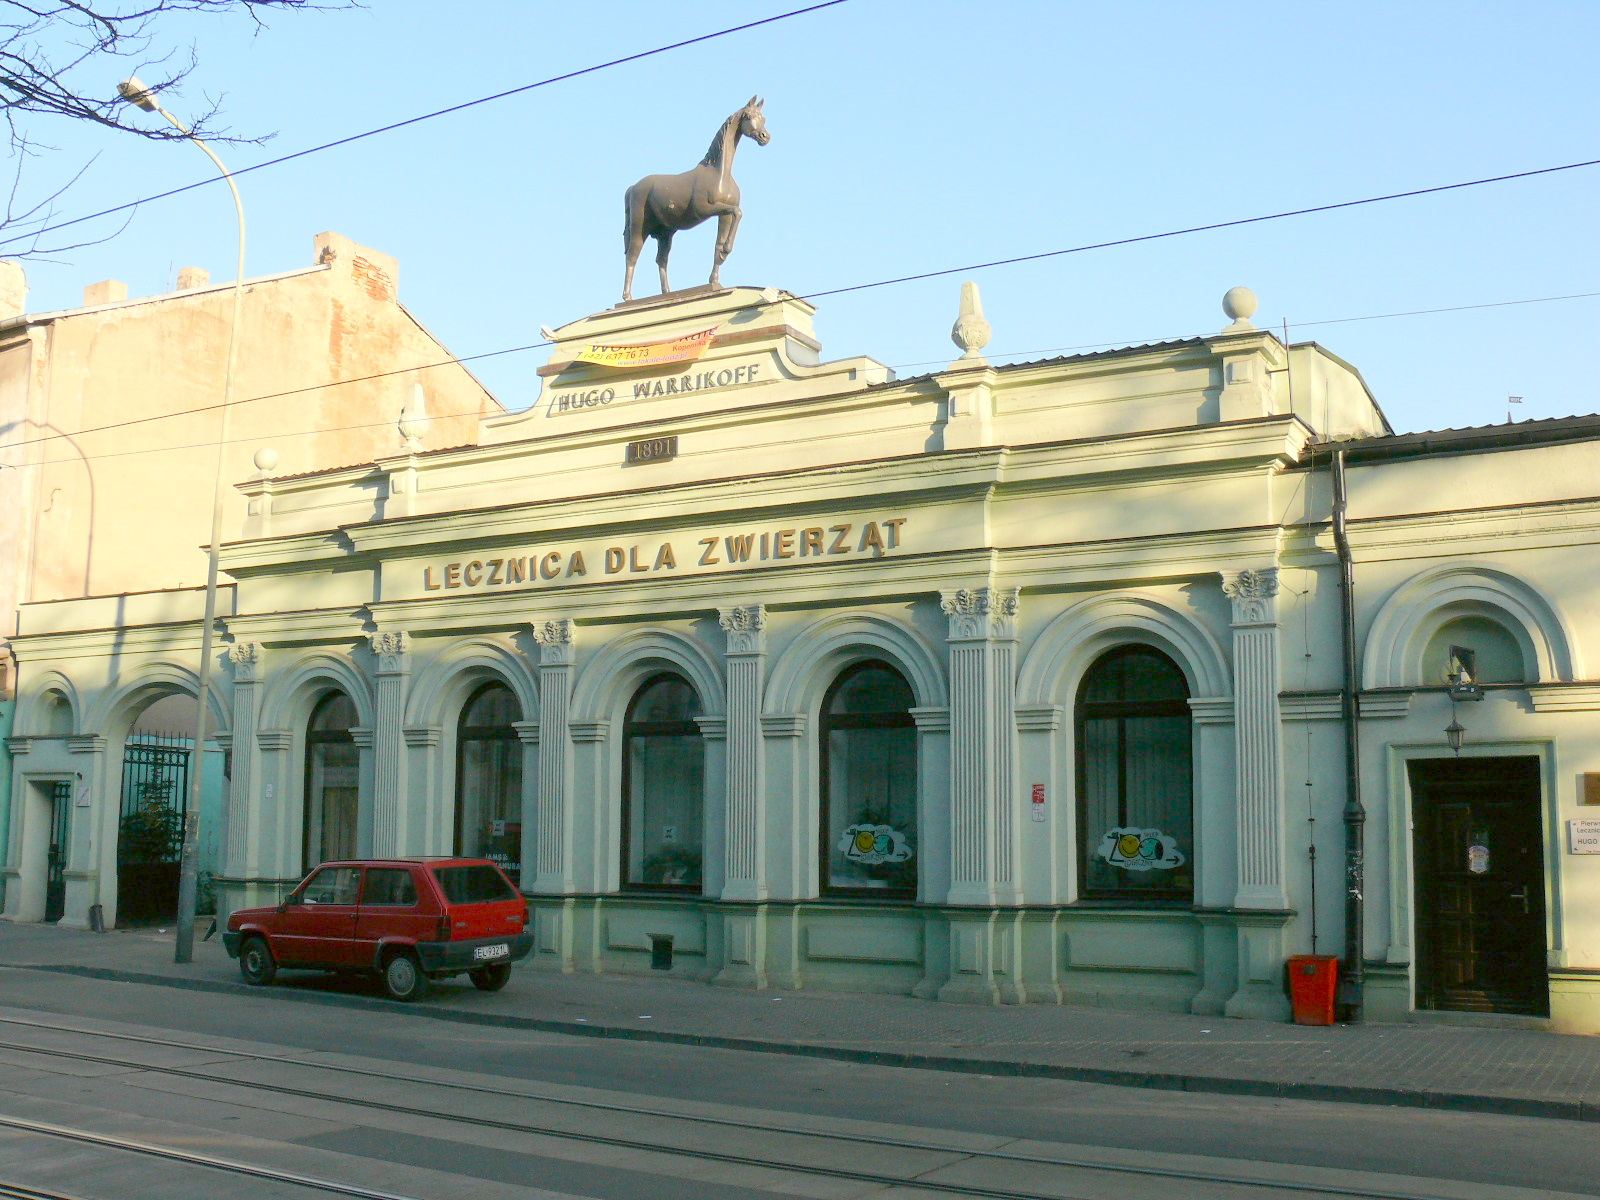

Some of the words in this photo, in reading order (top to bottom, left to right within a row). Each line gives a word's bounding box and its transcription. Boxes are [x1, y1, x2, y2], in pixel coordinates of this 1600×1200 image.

[626, 350, 636, 360] 76
[639, 348, 650, 358] 73
[558, 387, 615, 412] HUGO
[633, 363, 761, 399] WARRIKOFF
[633, 439, 673, 460] 1891
[424, 550, 587, 591] LECZNICA
[604, 542, 677, 575] DLA
[697, 517, 907, 567] ZWIERZĄT
